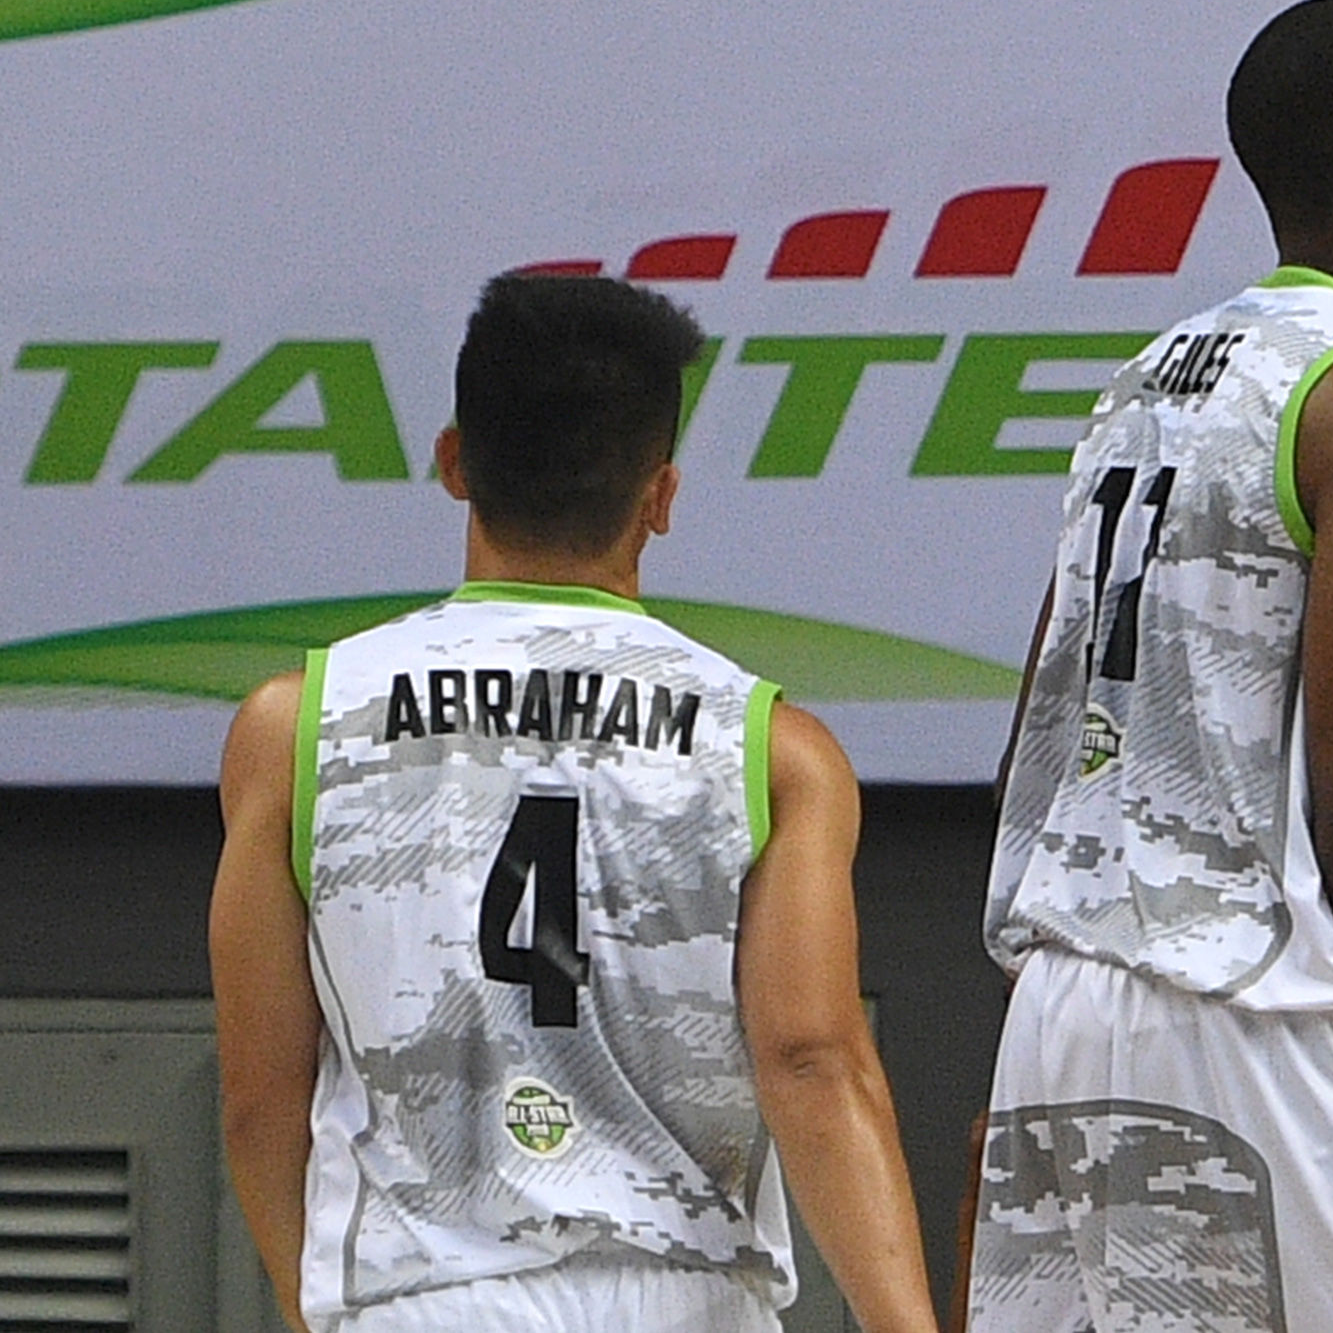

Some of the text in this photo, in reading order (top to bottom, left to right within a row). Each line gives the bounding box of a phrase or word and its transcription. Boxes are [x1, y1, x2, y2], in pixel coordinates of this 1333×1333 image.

[1142, 333, 1245, 395] GILES
[1086, 466, 1178, 684] 11
[385, 667, 701, 757] ABRAHAM
[479, 793, 590, 1030] 4
